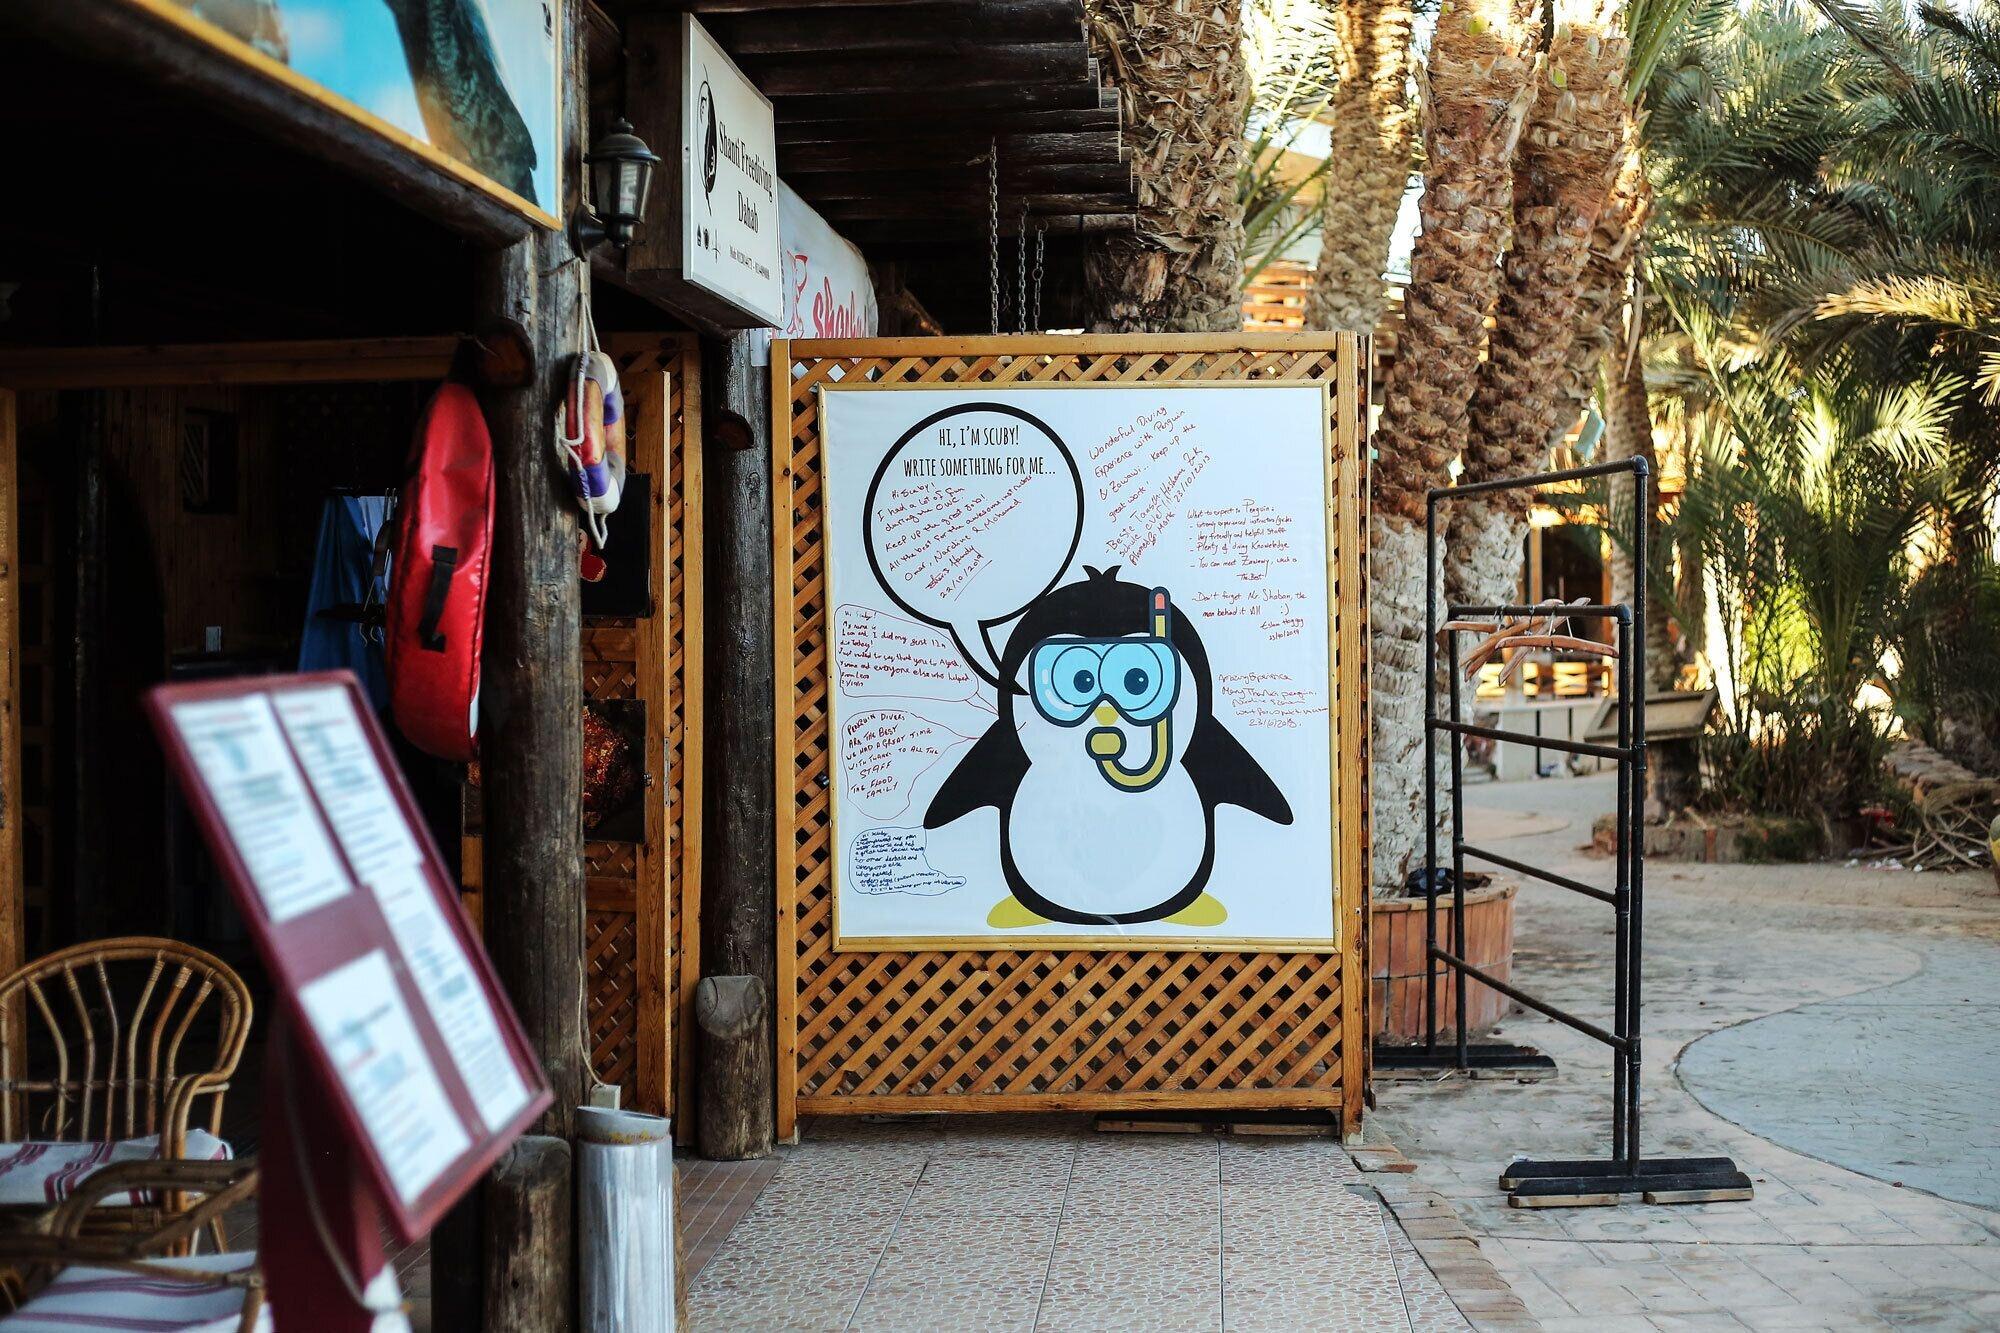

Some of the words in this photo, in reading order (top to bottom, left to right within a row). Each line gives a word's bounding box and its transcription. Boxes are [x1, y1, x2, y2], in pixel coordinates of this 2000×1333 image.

[719, 120, 741, 169] Shanti
[741, 140, 773, 203] Freediving
[737, 190, 759, 234] Dahab
[939, 428, 957, 448] HI,
[959, 426, 980, 446] I'M
[984, 424, 1019, 446] SCUBY!
[1089, 425, 1135, 460] Wonderful
[1137, 406, 1168, 427] Diving
[1150, 447, 1168, 461] Keep
[1169, 435, 1180, 446] up
[1183, 423, 1197, 433] the
[1095, 451, 1133, 478] Experience
[1134, 432, 1153, 449] with
[1154, 410, 1185, 432] Penguin
[903, 458, 936, 477] WRITE
[940, 457, 1003, 476] SOMETHING
[1006, 457, 1026, 475] FOR
[877, 510, 885, 522] I
[888, 503, 907, 515] had
[919, 496, 930, 506] lot
[933, 490, 943, 500] of
[945, 487, 965, 498] fun
[892, 490, 899, 500] Hi
[1109, 502, 1126, 523] great
[1187, 509, 1203, 519] What
[885, 514, 920, 532] during
[885, 535, 907, 552] Keep
[911, 530, 921, 540] up
[889, 560, 900, 571] All
[900, 553, 916, 562] the
[914, 540, 932, 553] best
[934, 532, 947, 541] for
[947, 525, 964, 533] the
[966, 501, 1001, 525] awesome
[1209, 530, 1232, 544] friendly
[1245, 528, 1264, 538] helpful
[1197, 542, 1219, 555] Plenty
[1199, 557, 1208, 568] You
[1222, 591, 1242, 605] forget
[1217, 607, 1238, 616] behind
[1239, 607, 1246, 615] it
[881, 631, 894, 640] did
[895, 635, 907, 644] my
[874, 665, 910, 677] everyone
[847, 713, 876, 736] PENGUIN
[879, 723, 898, 737] BEST
[846, 751, 857, 760] WE
[860, 744, 873, 755] HAD
[882, 734, 906, 749] GREAT
[848, 759, 867, 771] WITH
[910, 745, 923, 753] ALL
[926, 746, 939, 755] THE
[850, 783, 866, 794] THE
[866, 781, 899, 799] FAMILY
